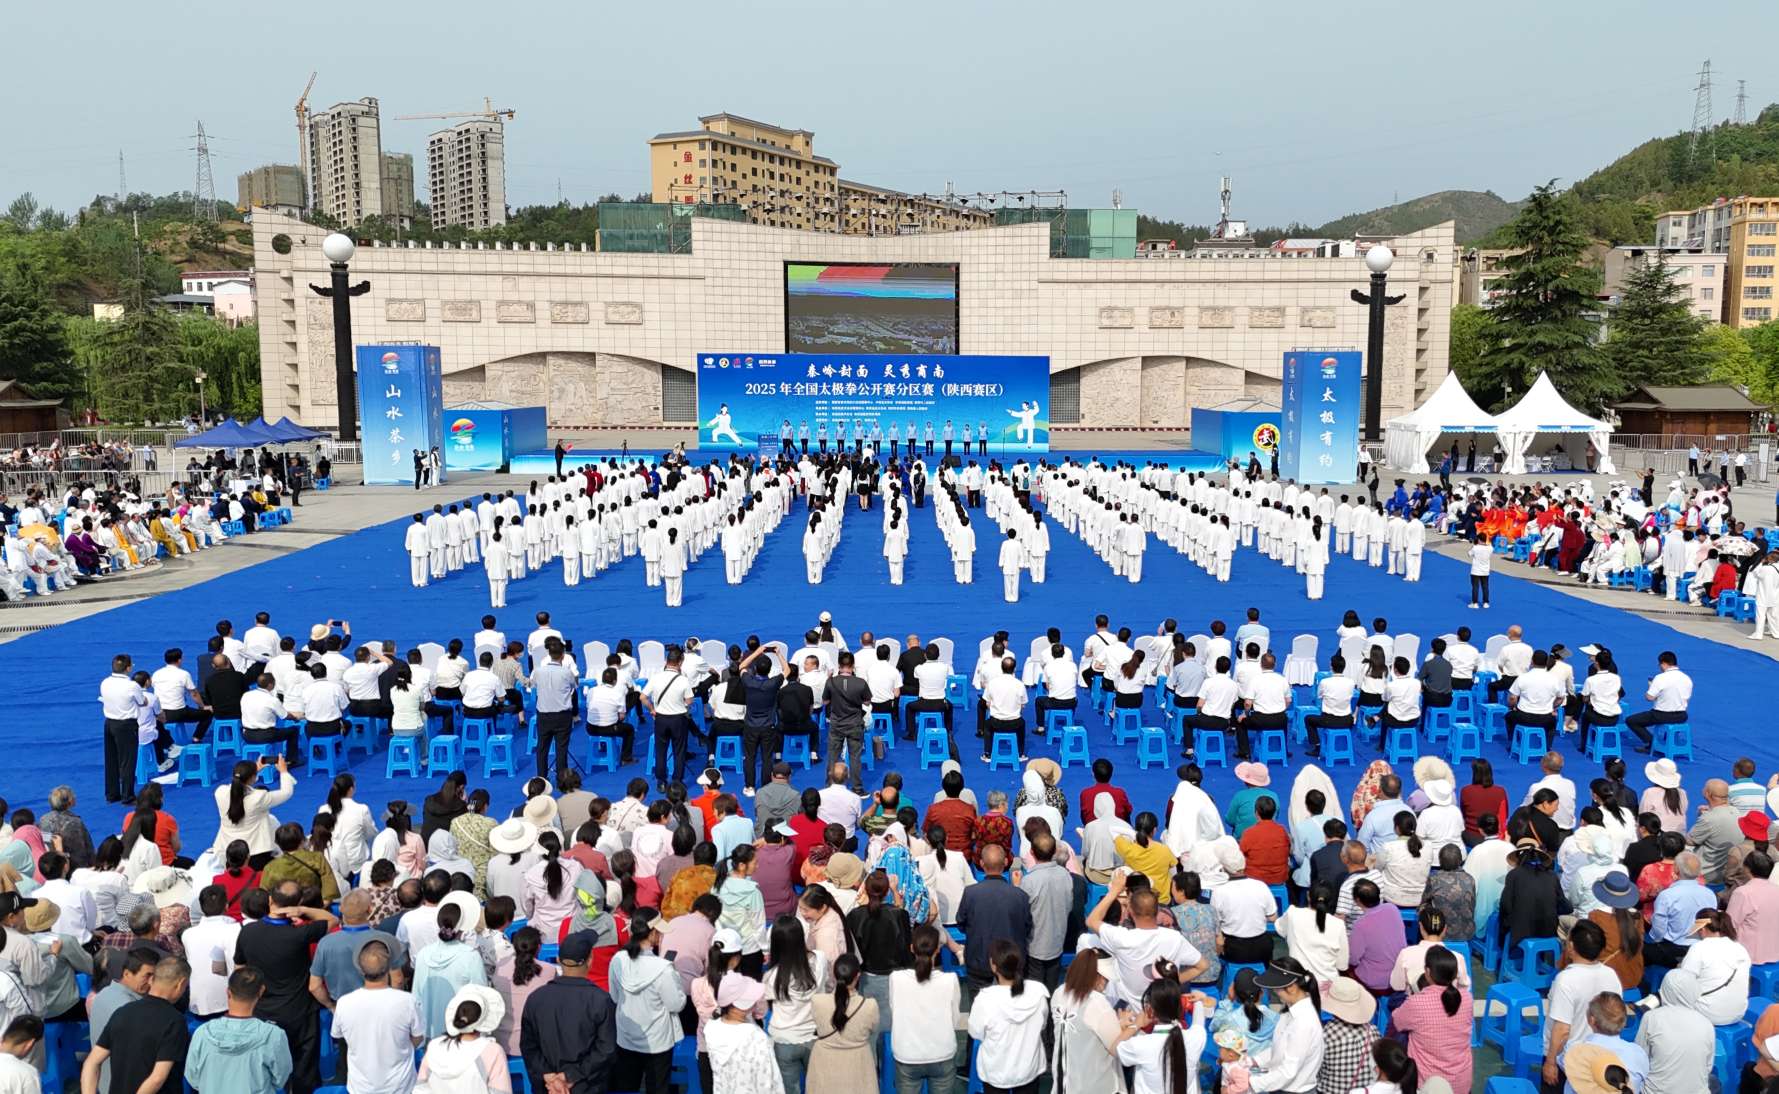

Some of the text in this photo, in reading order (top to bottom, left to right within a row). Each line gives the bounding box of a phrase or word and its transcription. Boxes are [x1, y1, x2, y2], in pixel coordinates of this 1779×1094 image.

[745, 383, 776, 395] 2025
[806, 362, 869, 379] 秦岭封面
[386, 384, 404, 466] 山水茶乡
[1320, 387, 1337, 466] 太极有约
